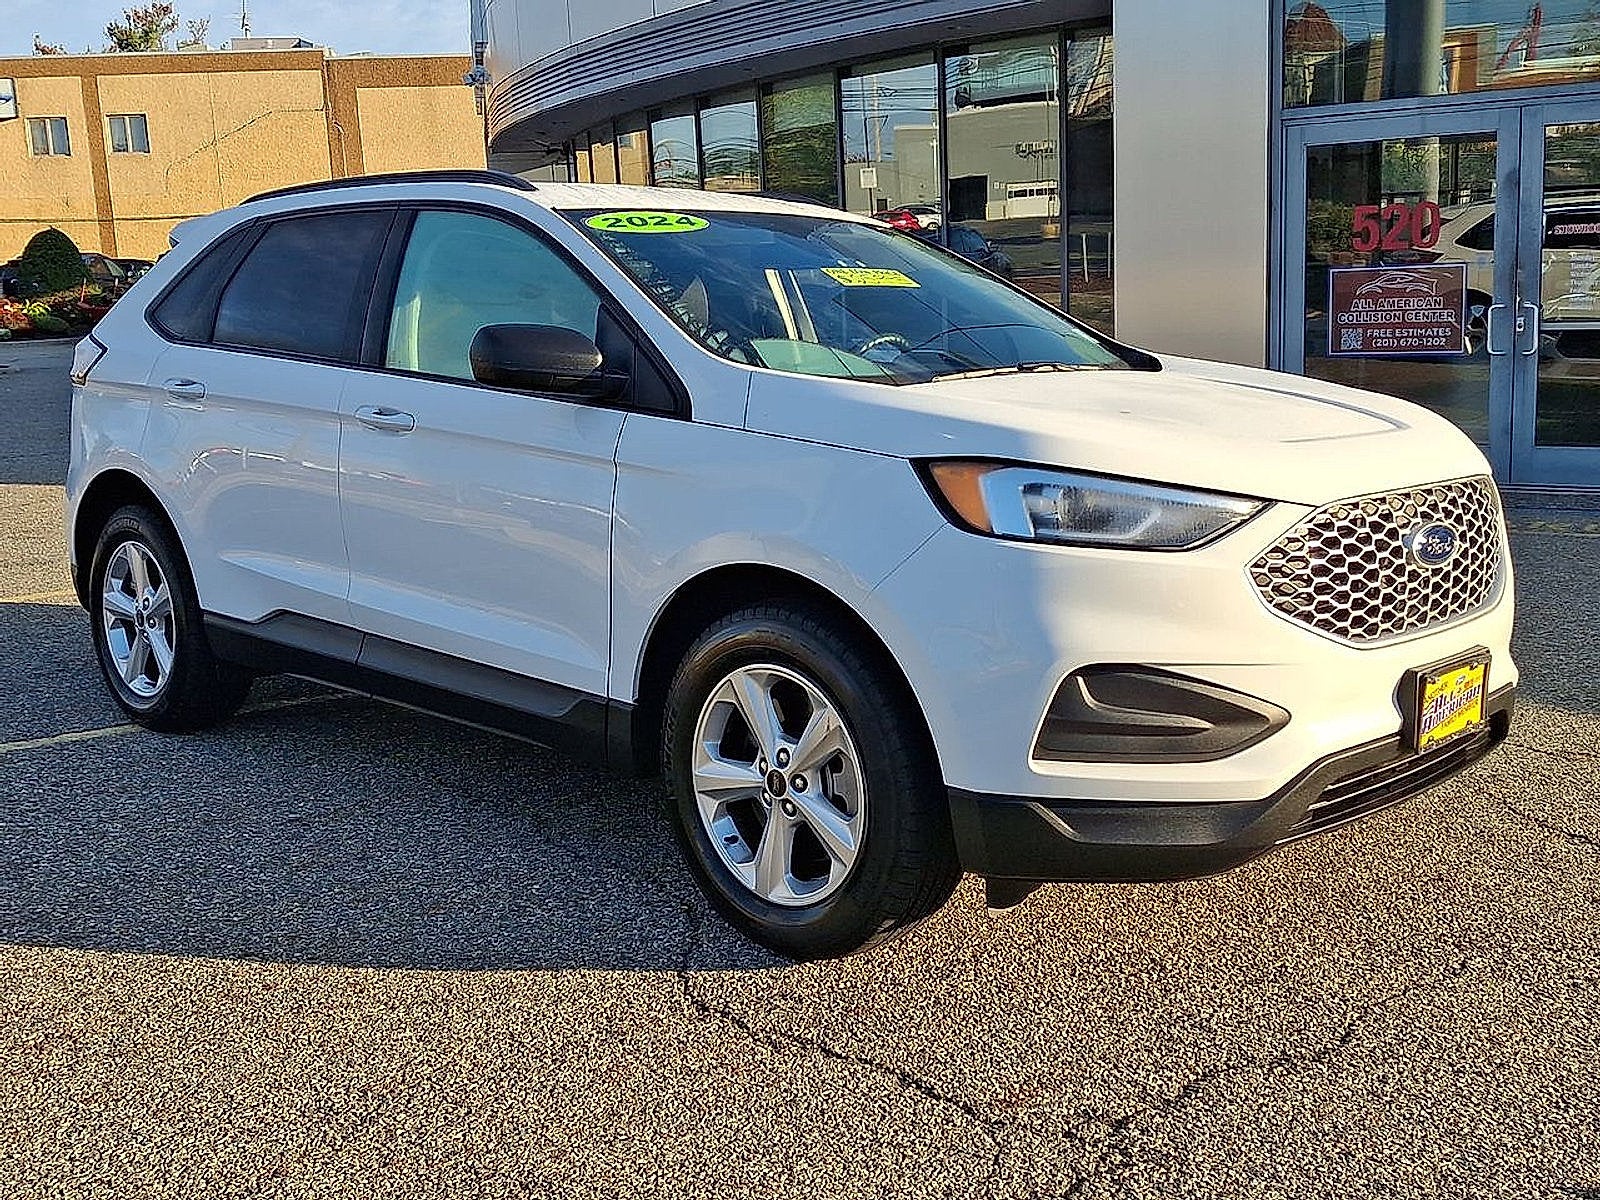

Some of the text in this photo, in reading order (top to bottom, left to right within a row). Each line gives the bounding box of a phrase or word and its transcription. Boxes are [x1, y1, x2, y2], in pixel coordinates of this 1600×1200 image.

[602, 216, 696, 228] 2024
[1352, 201, 1440, 252] 520
[1351, 297, 1443, 311] ALL AMERICAN
[1338, 310, 1455, 323] COLLISION CENTER
[1366, 328, 1452, 338] FREE ESTIMATES
[1372, 338, 1446, 348] (201) 670-1202
